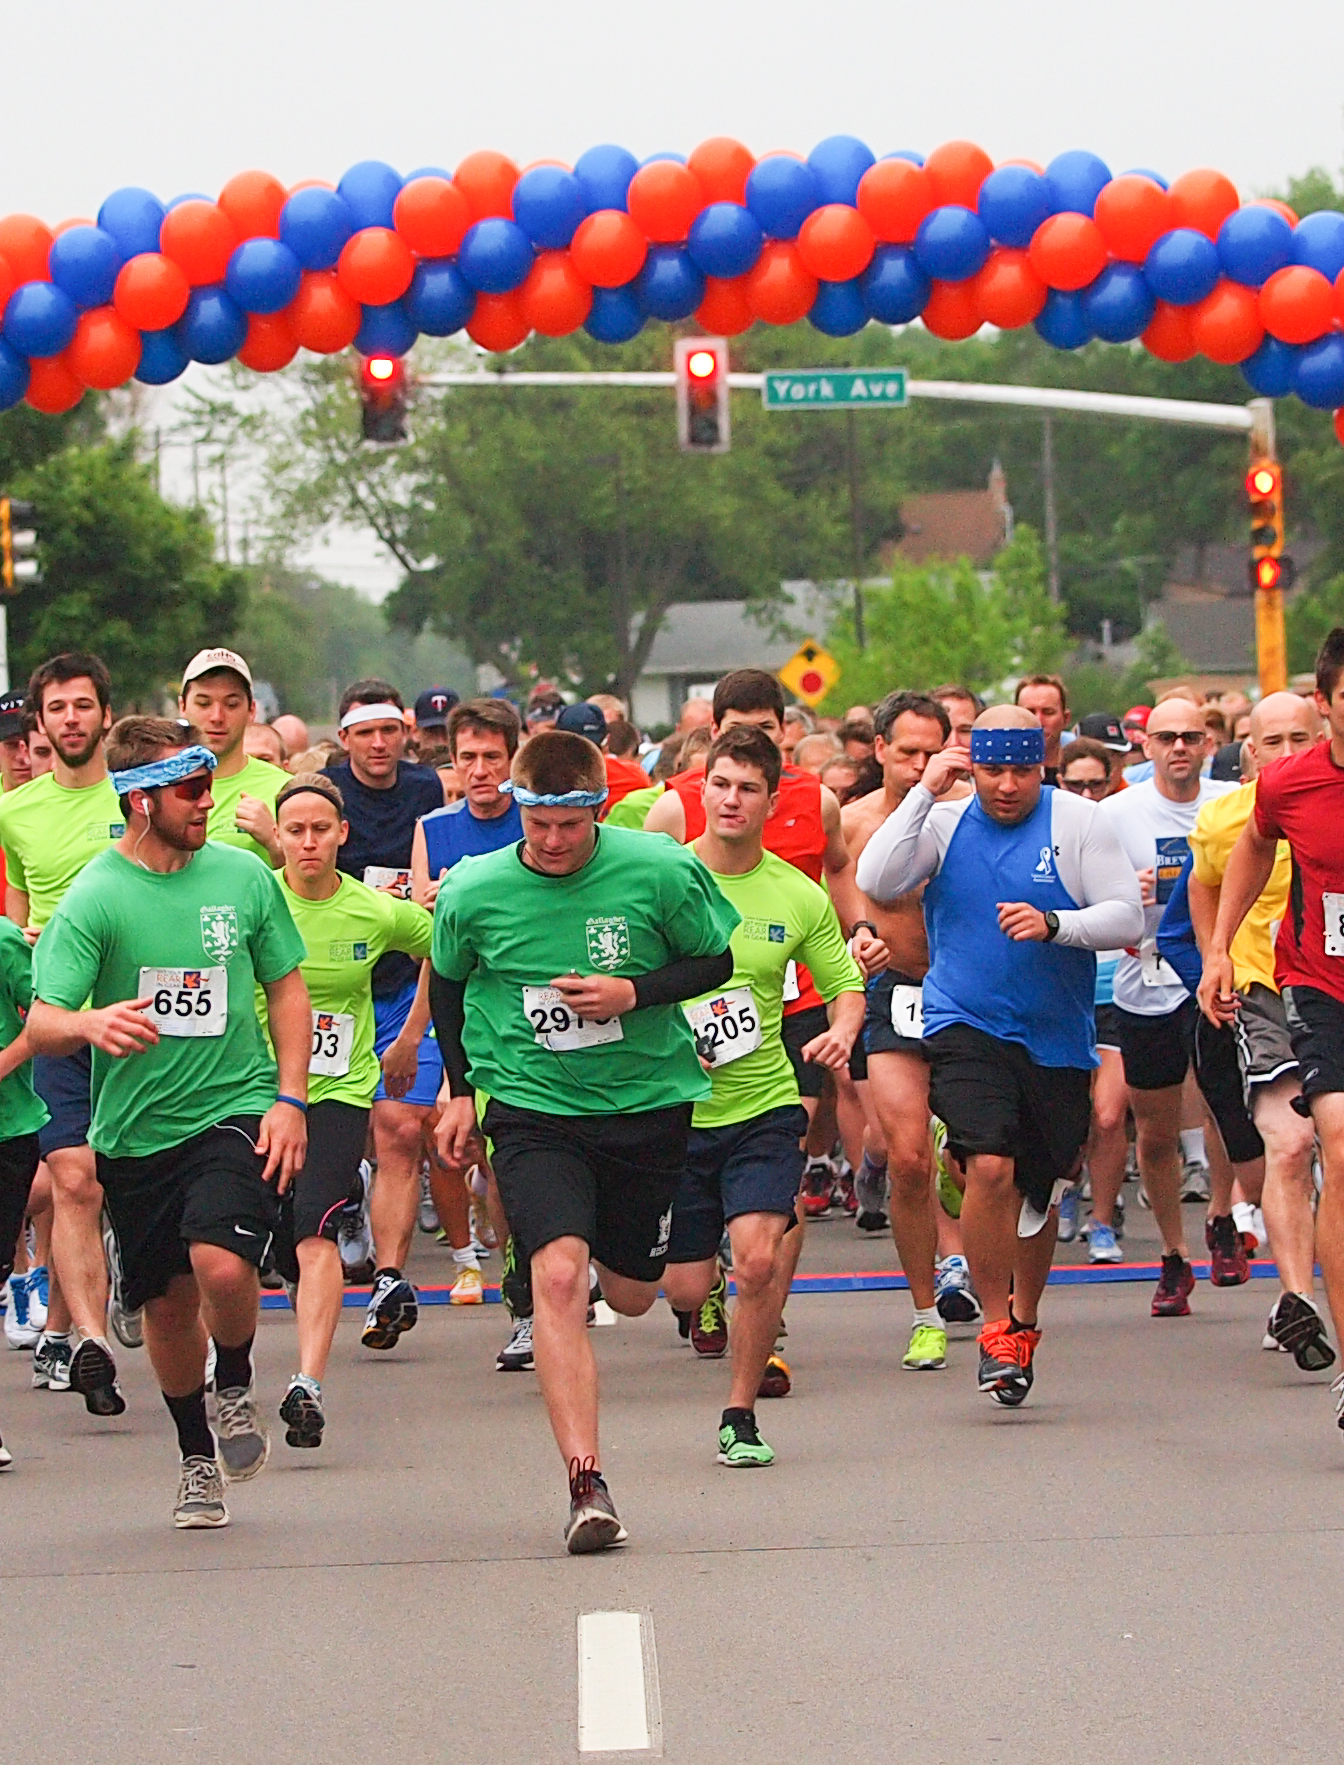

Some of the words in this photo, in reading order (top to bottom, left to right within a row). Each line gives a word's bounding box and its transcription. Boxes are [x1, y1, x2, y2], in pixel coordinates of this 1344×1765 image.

[772, 377, 835, 400] York
[850, 377, 899, 399] Ave
[154, 989, 212, 1017] 655
[530, 1007, 611, 1034] 29
